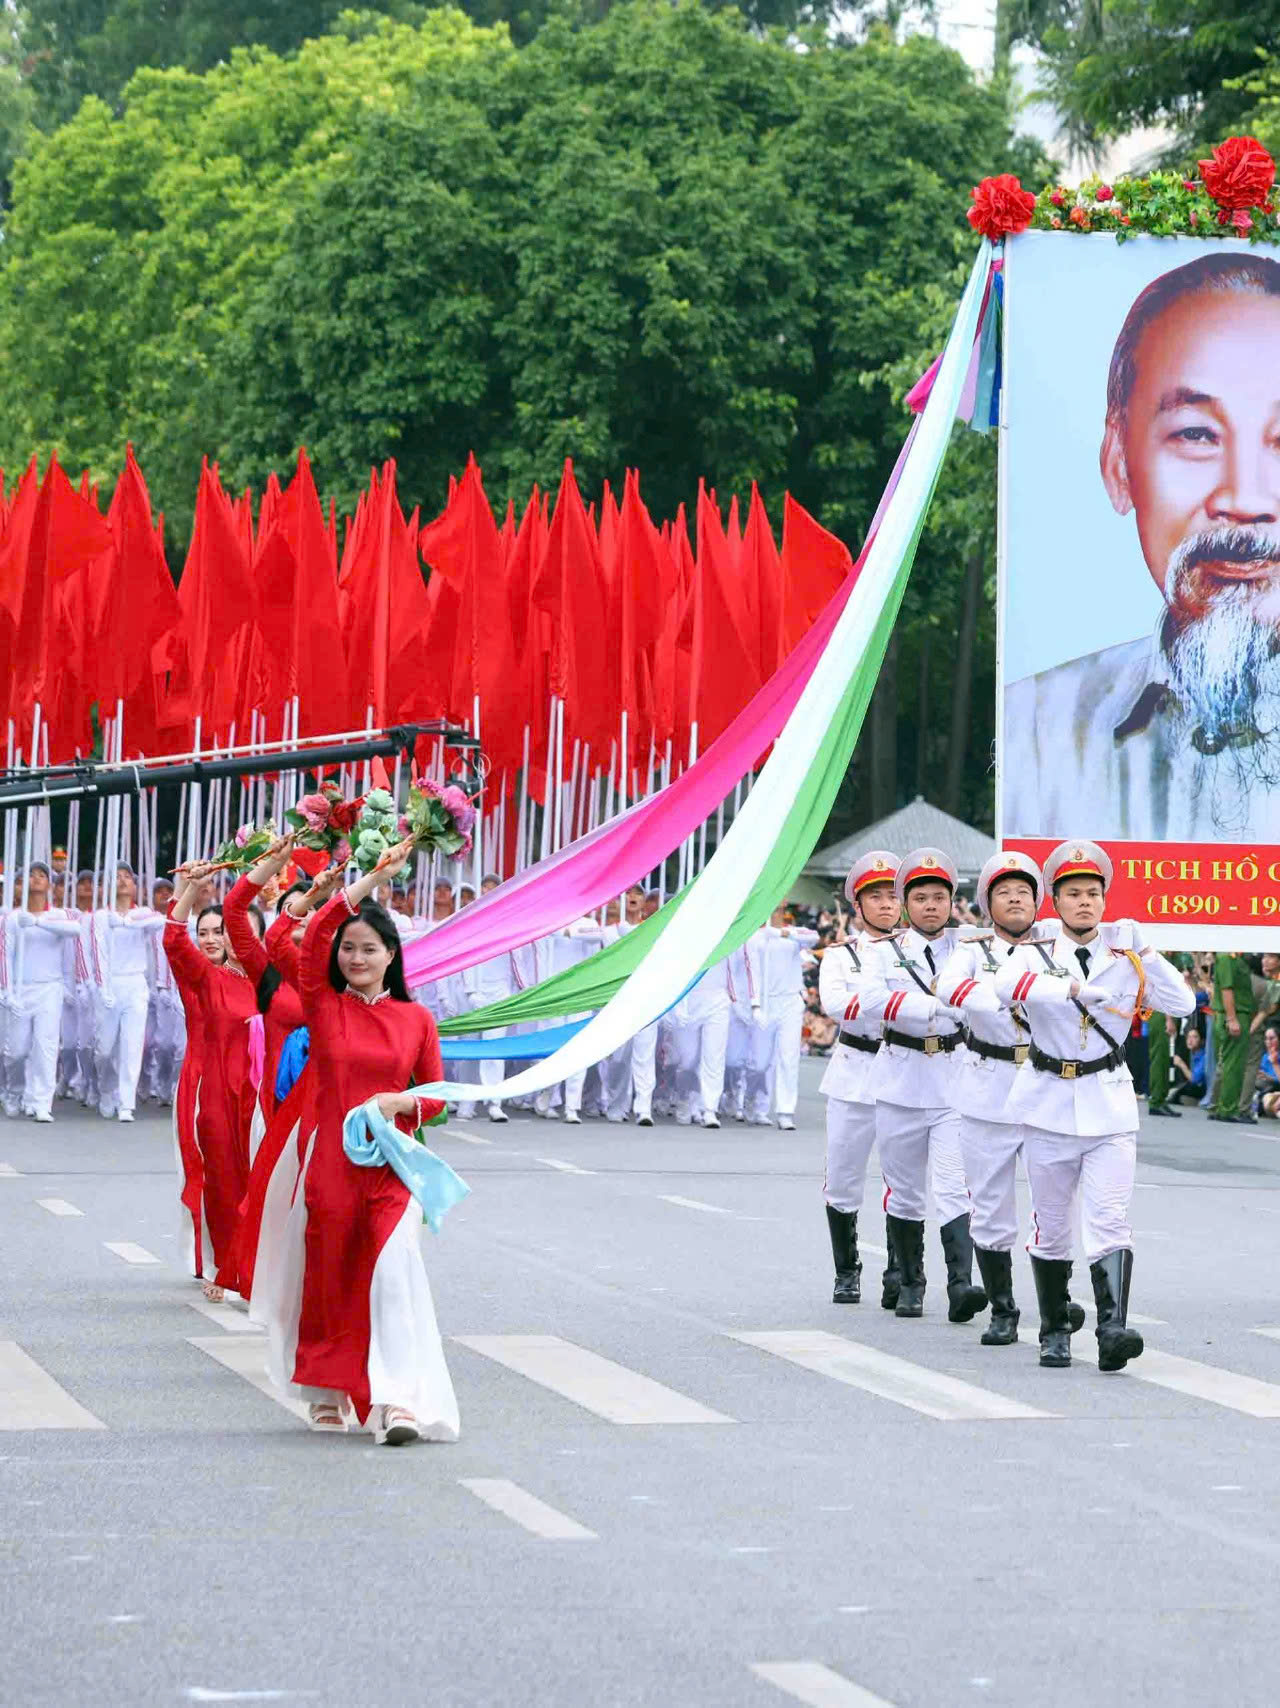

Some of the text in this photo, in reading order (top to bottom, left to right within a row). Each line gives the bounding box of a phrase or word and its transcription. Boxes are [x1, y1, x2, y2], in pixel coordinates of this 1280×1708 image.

[1121, 859, 1201, 884] TỊCH
[1211, 853, 1258, 881] HỒ
[1147, 895, 1220, 917] (1890
